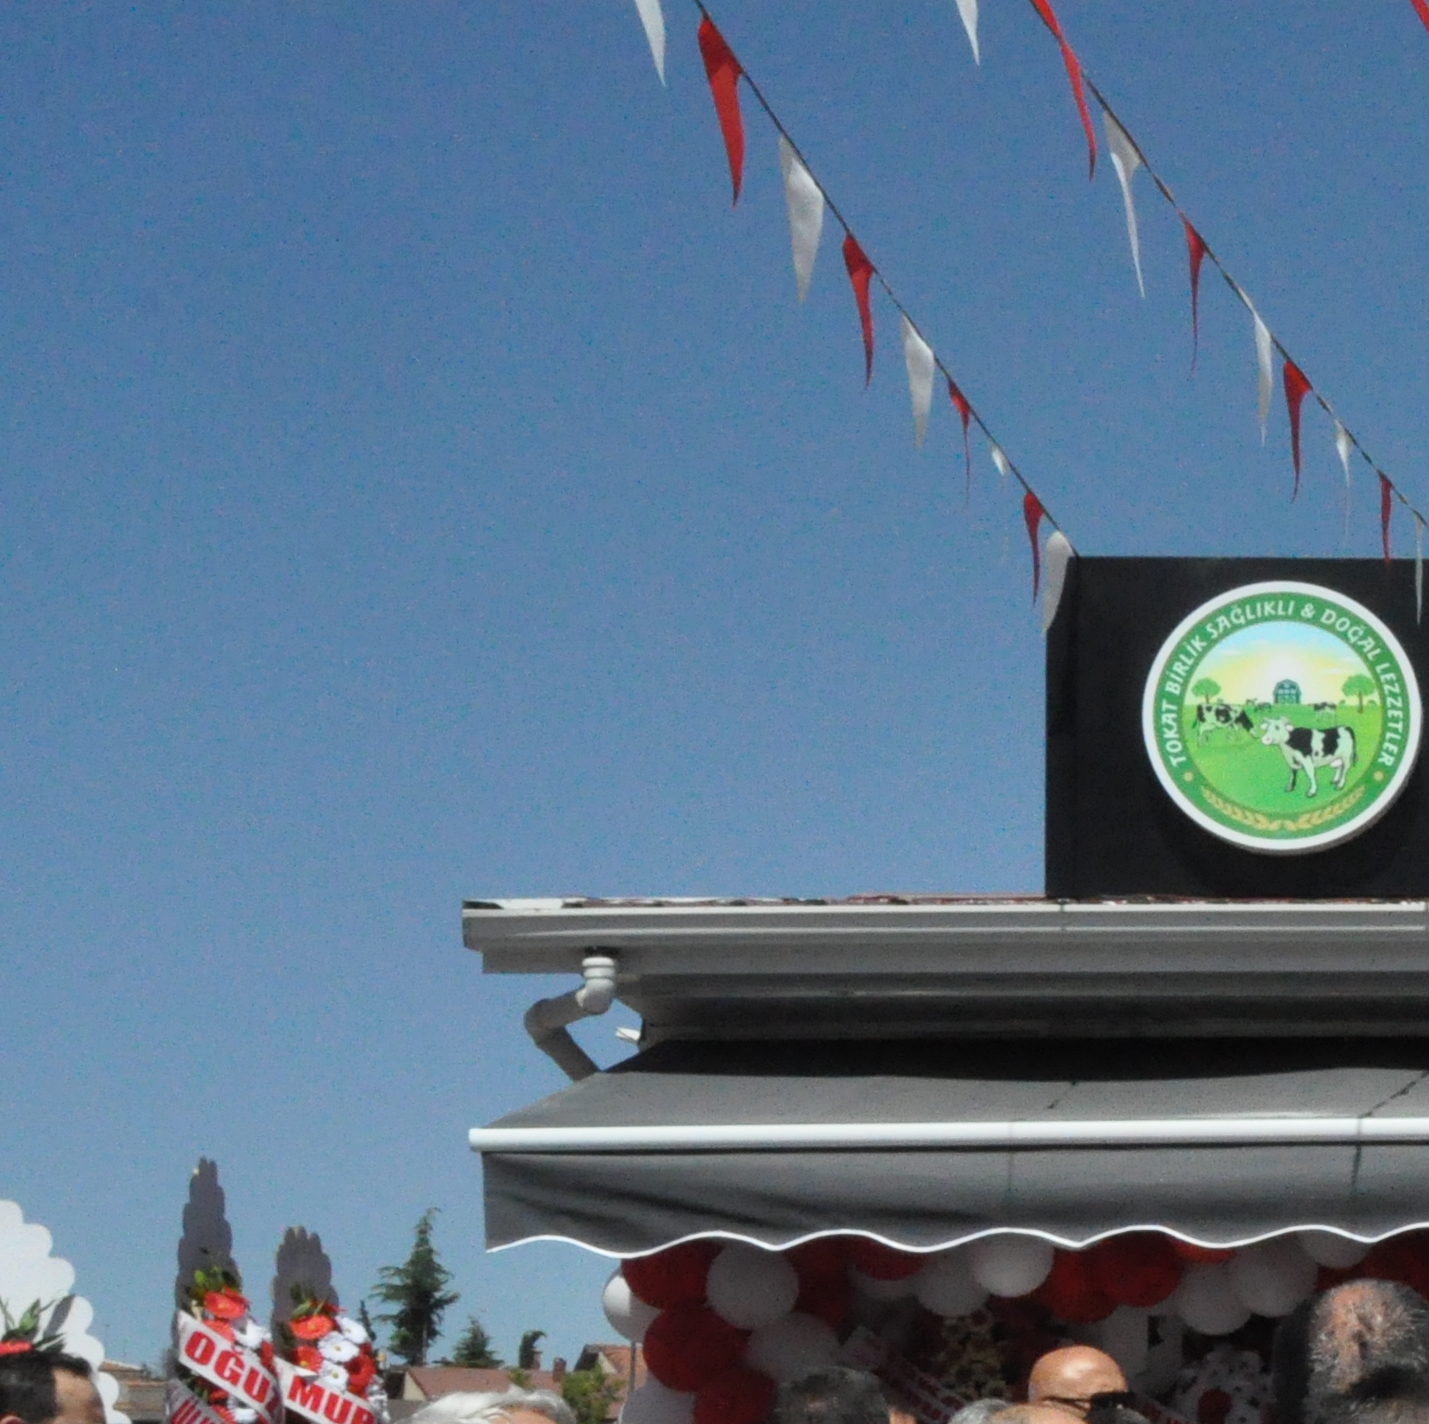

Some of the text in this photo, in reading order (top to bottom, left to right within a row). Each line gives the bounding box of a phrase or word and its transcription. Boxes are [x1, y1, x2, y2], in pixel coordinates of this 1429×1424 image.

[1161, 600, 1404, 767] TOKAT BİRLİK SAĞLIKLI & DOĞAL LEZZETLER
